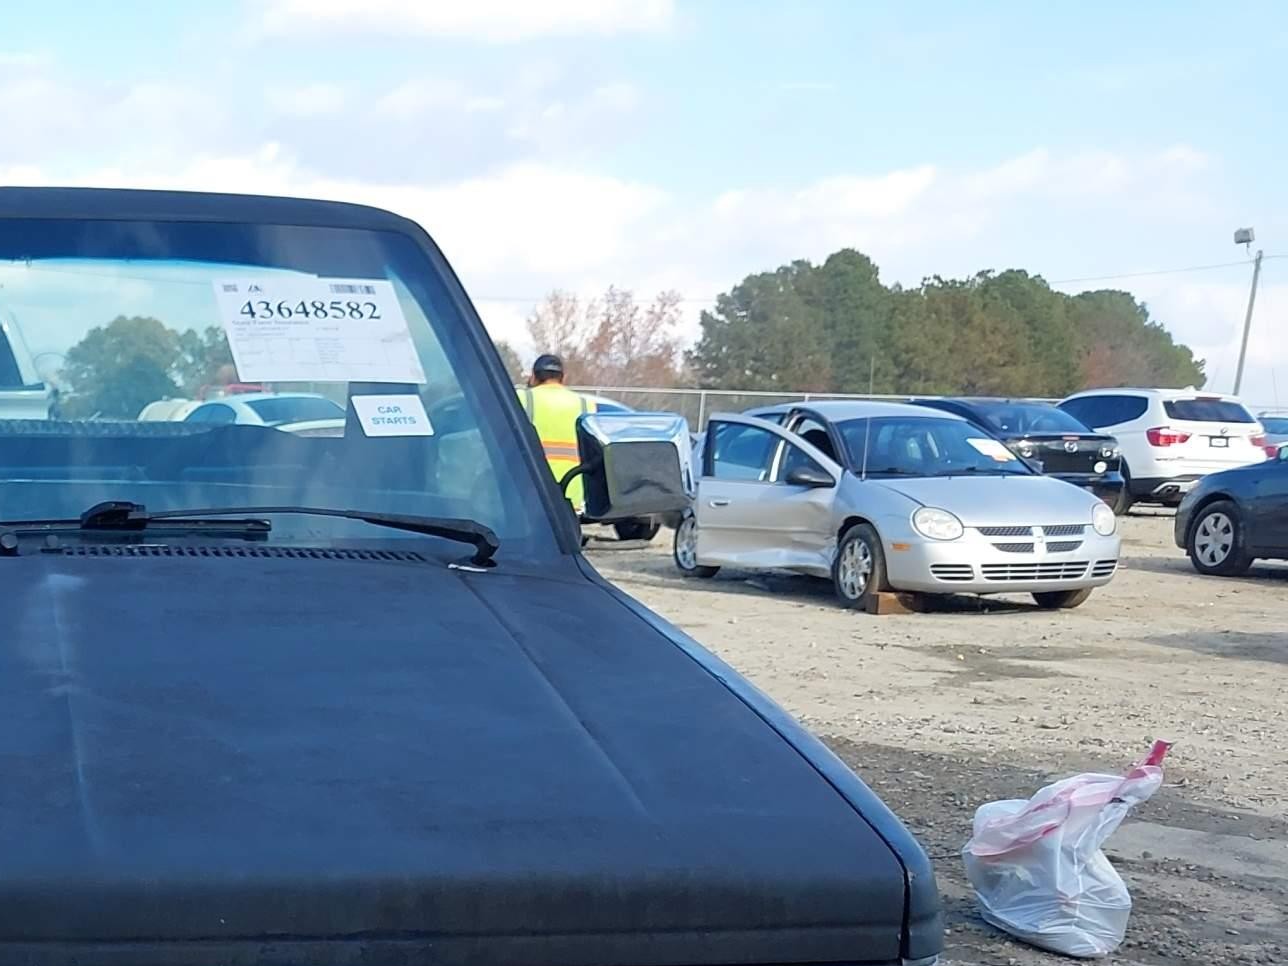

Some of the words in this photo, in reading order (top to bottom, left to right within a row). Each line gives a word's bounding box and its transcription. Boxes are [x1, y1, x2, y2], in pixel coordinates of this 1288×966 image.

[240, 300, 382, 320] 43648582
[377, 406, 402, 414] CAR
[371, 416, 417, 425] STARTS
